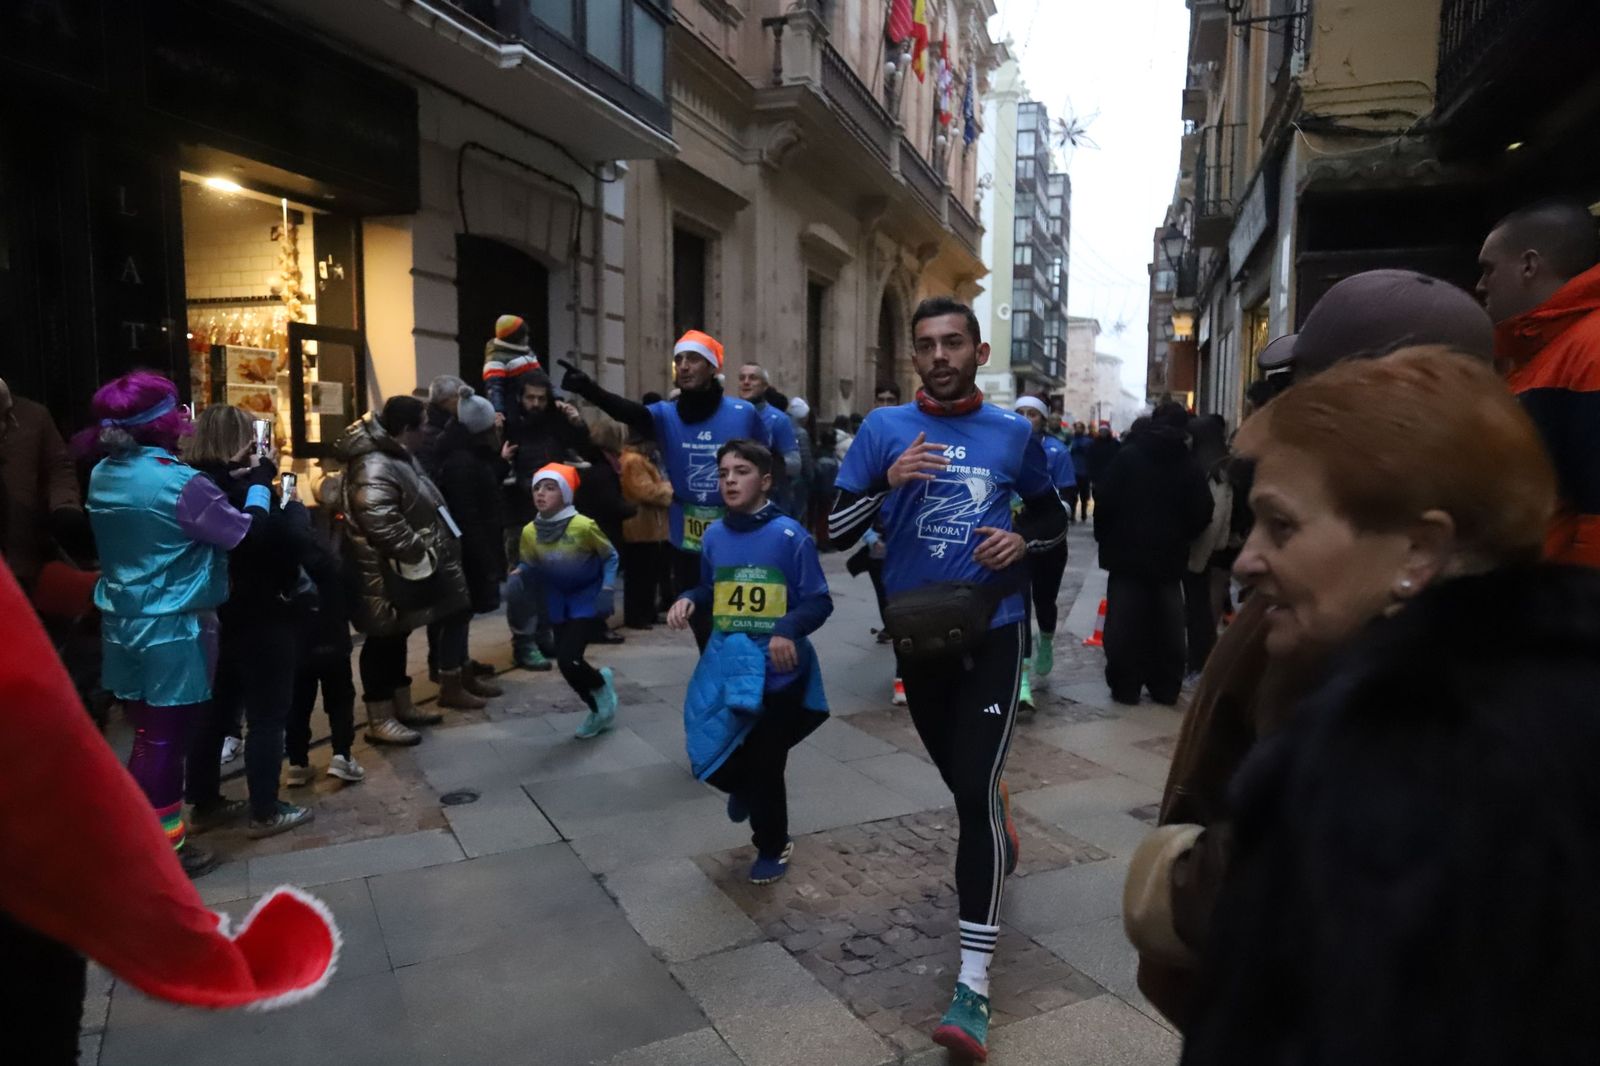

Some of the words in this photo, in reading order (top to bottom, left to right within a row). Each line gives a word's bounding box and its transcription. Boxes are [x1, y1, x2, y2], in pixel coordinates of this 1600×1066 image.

[697, 431, 712, 441] 46
[943, 445, 966, 459] 46
[727, 585, 766, 612] 49
